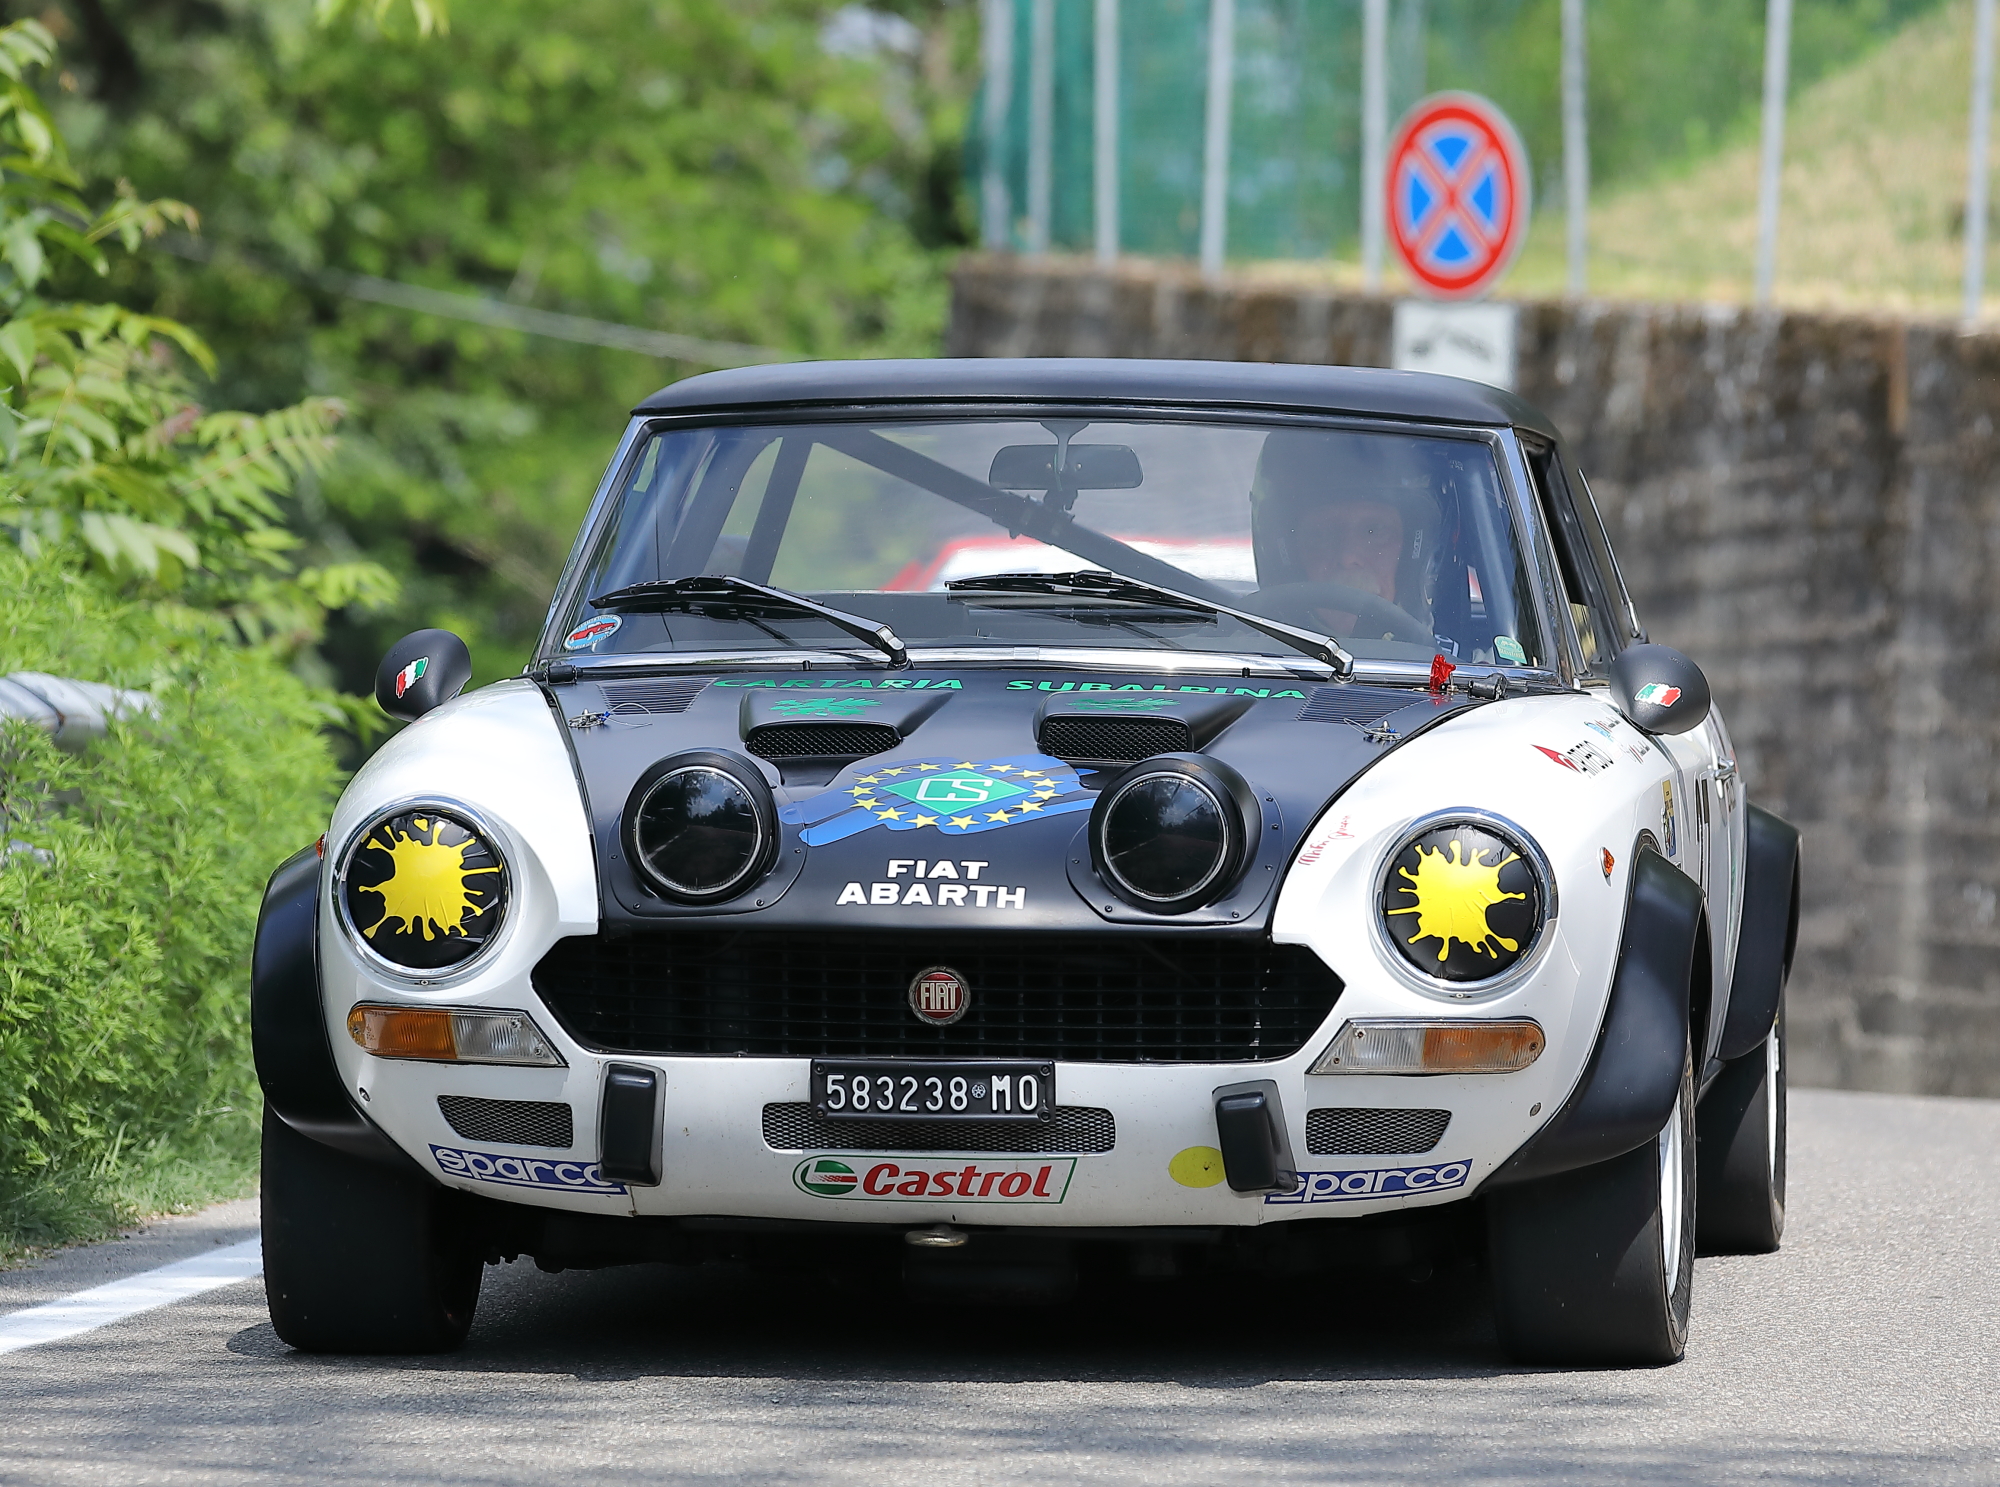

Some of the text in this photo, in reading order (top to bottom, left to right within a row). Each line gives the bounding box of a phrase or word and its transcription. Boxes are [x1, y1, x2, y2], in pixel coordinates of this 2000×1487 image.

[713, 679, 963, 689] CARTARIA
[887, 860, 989, 880] FIAT
[836, 882, 1026, 910] ABARTH
[920, 983, 958, 1009] FIAT
[826, 1074, 1039, 1112] 583238 MO
[863, 1163, 1052, 1197] Castrol
